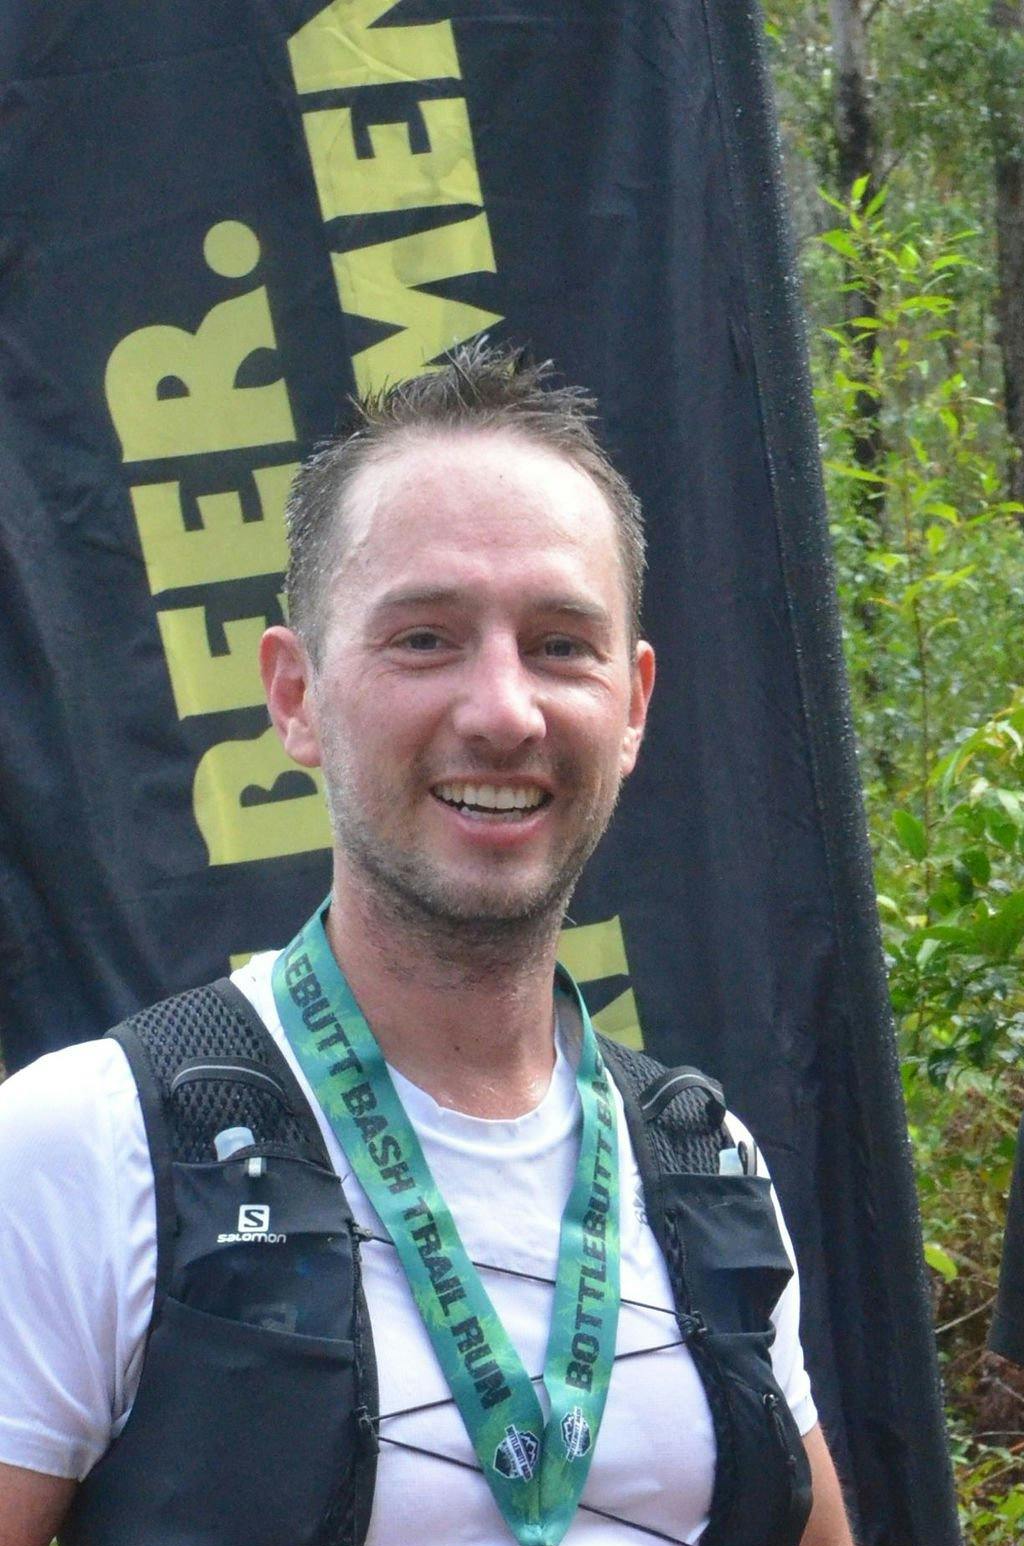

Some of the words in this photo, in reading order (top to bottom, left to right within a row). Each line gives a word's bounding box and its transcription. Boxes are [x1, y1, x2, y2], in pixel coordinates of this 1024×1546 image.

[217, 1232, 287, 1244] salomon
[340, 1082, 416, 1195] BASH
[403, 1198, 465, 1317] TRAIL
[450, 1315, 512, 1410] RUN
[565, 1129, 613, 1394] BOTTLEBUTT
